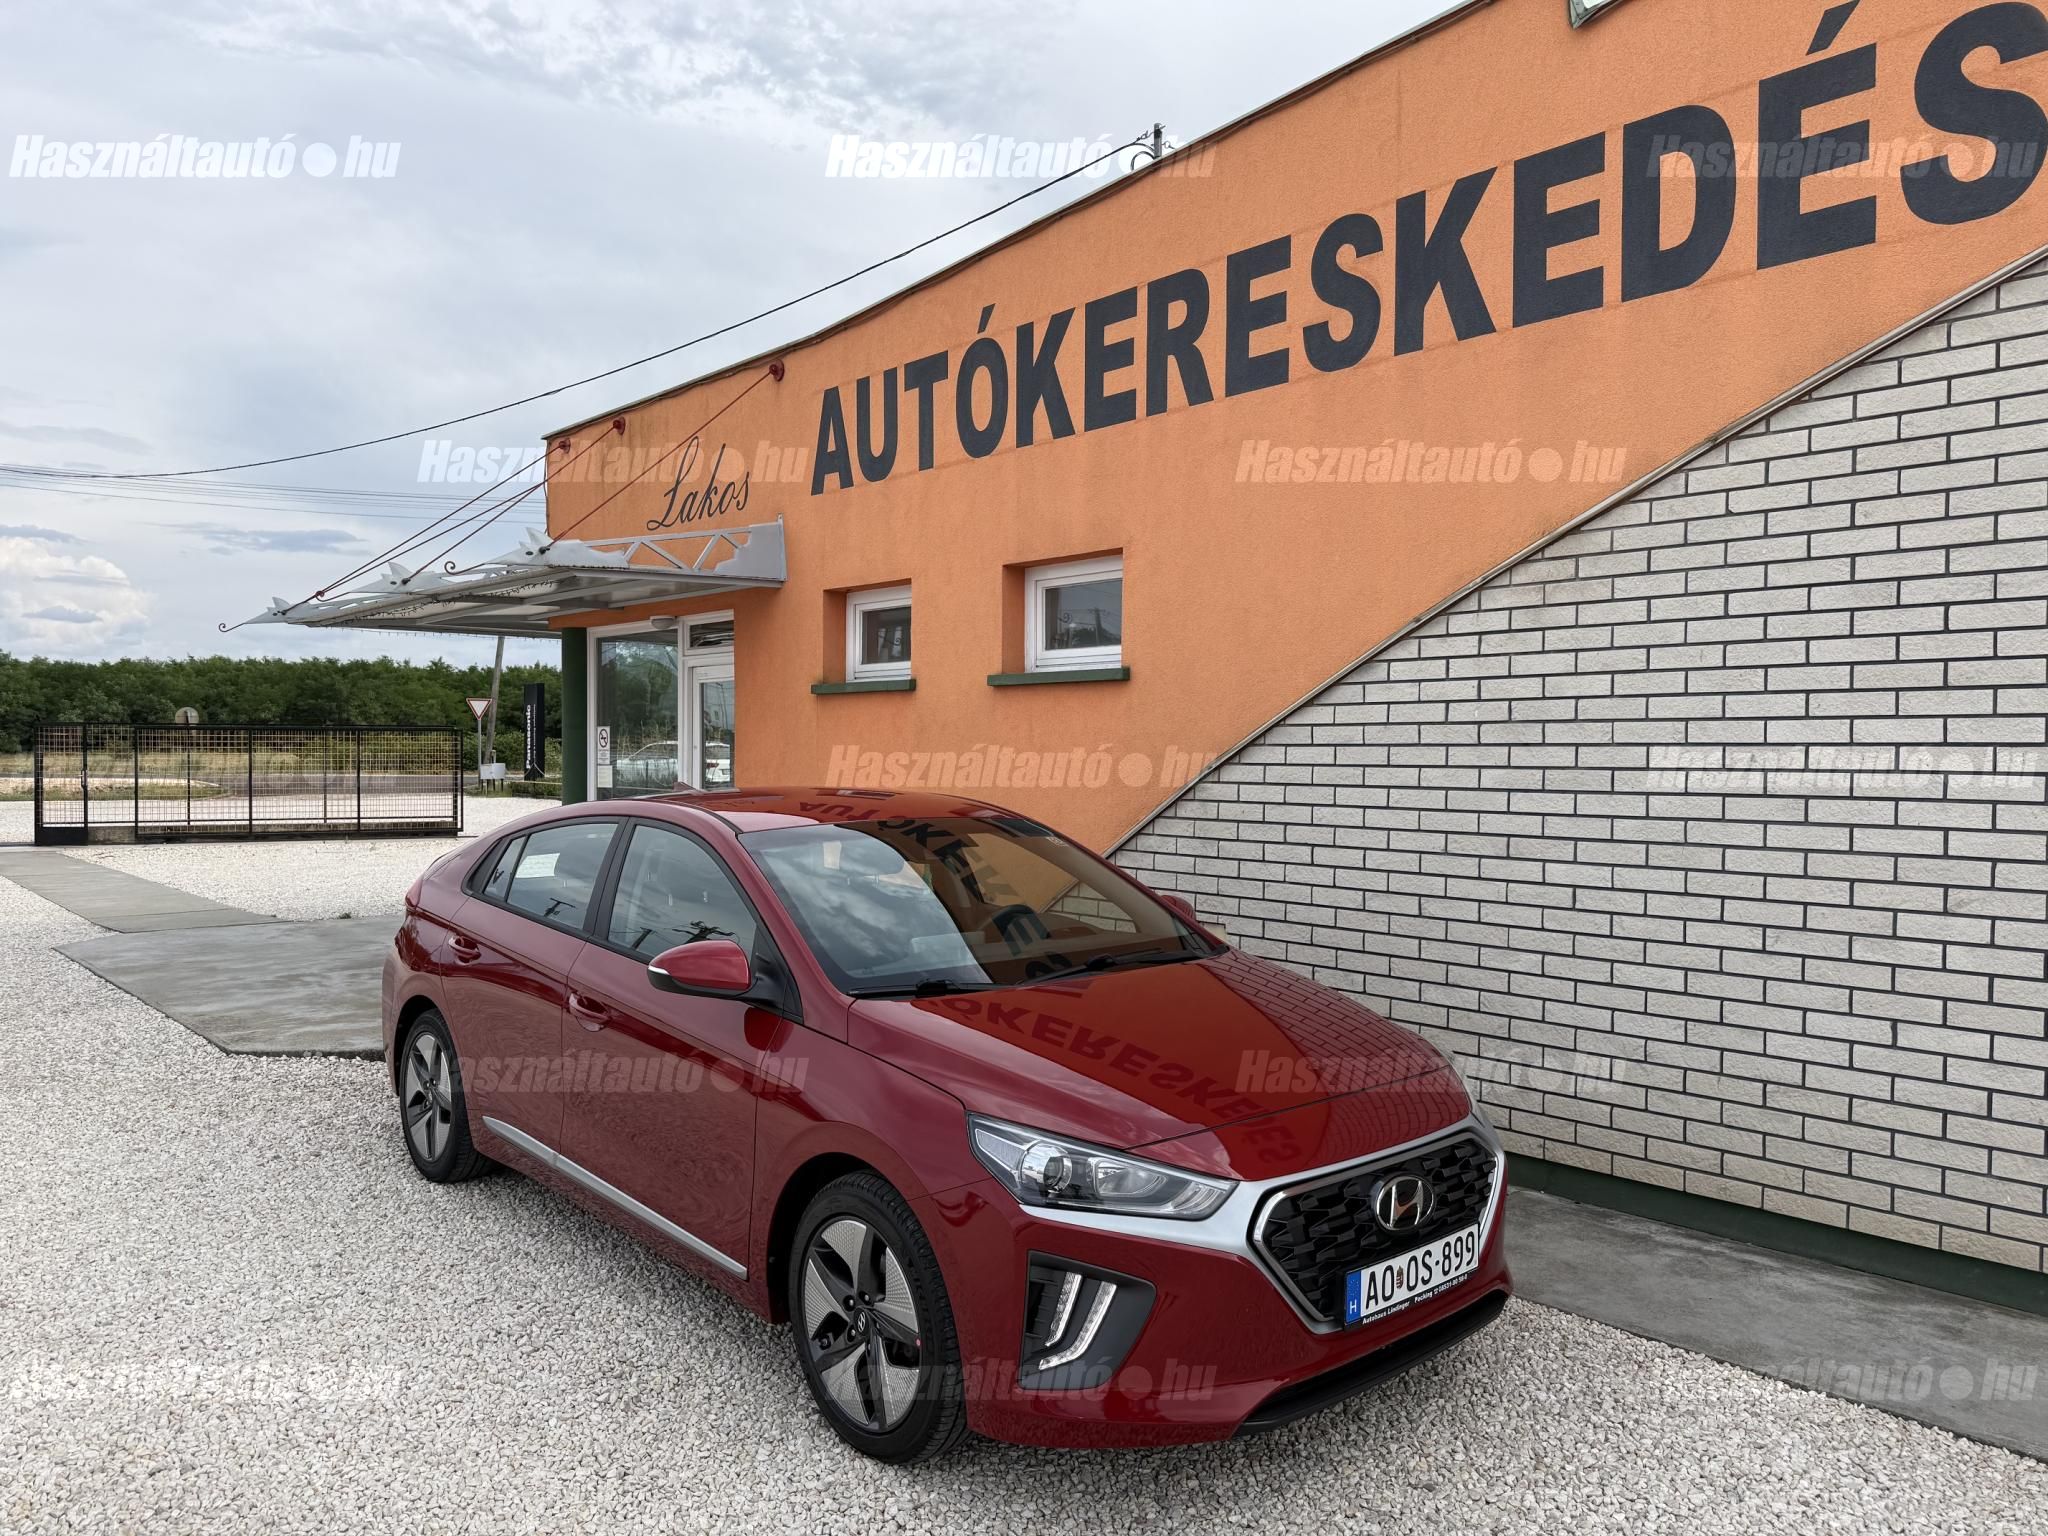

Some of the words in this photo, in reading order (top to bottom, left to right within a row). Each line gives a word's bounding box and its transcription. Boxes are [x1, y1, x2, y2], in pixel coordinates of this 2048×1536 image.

[810, 0, 2048, 495] AUTÓKERESKEDÉS
[646, 436, 750, 531] Lakos
[1349, 1299, 1358, 1314] H
[1365, 1264, 1395, 1310] AO
[1406, 1231, 1475, 1292] OS-899
[1362, 1309, 1387, 1325] Autohaus
